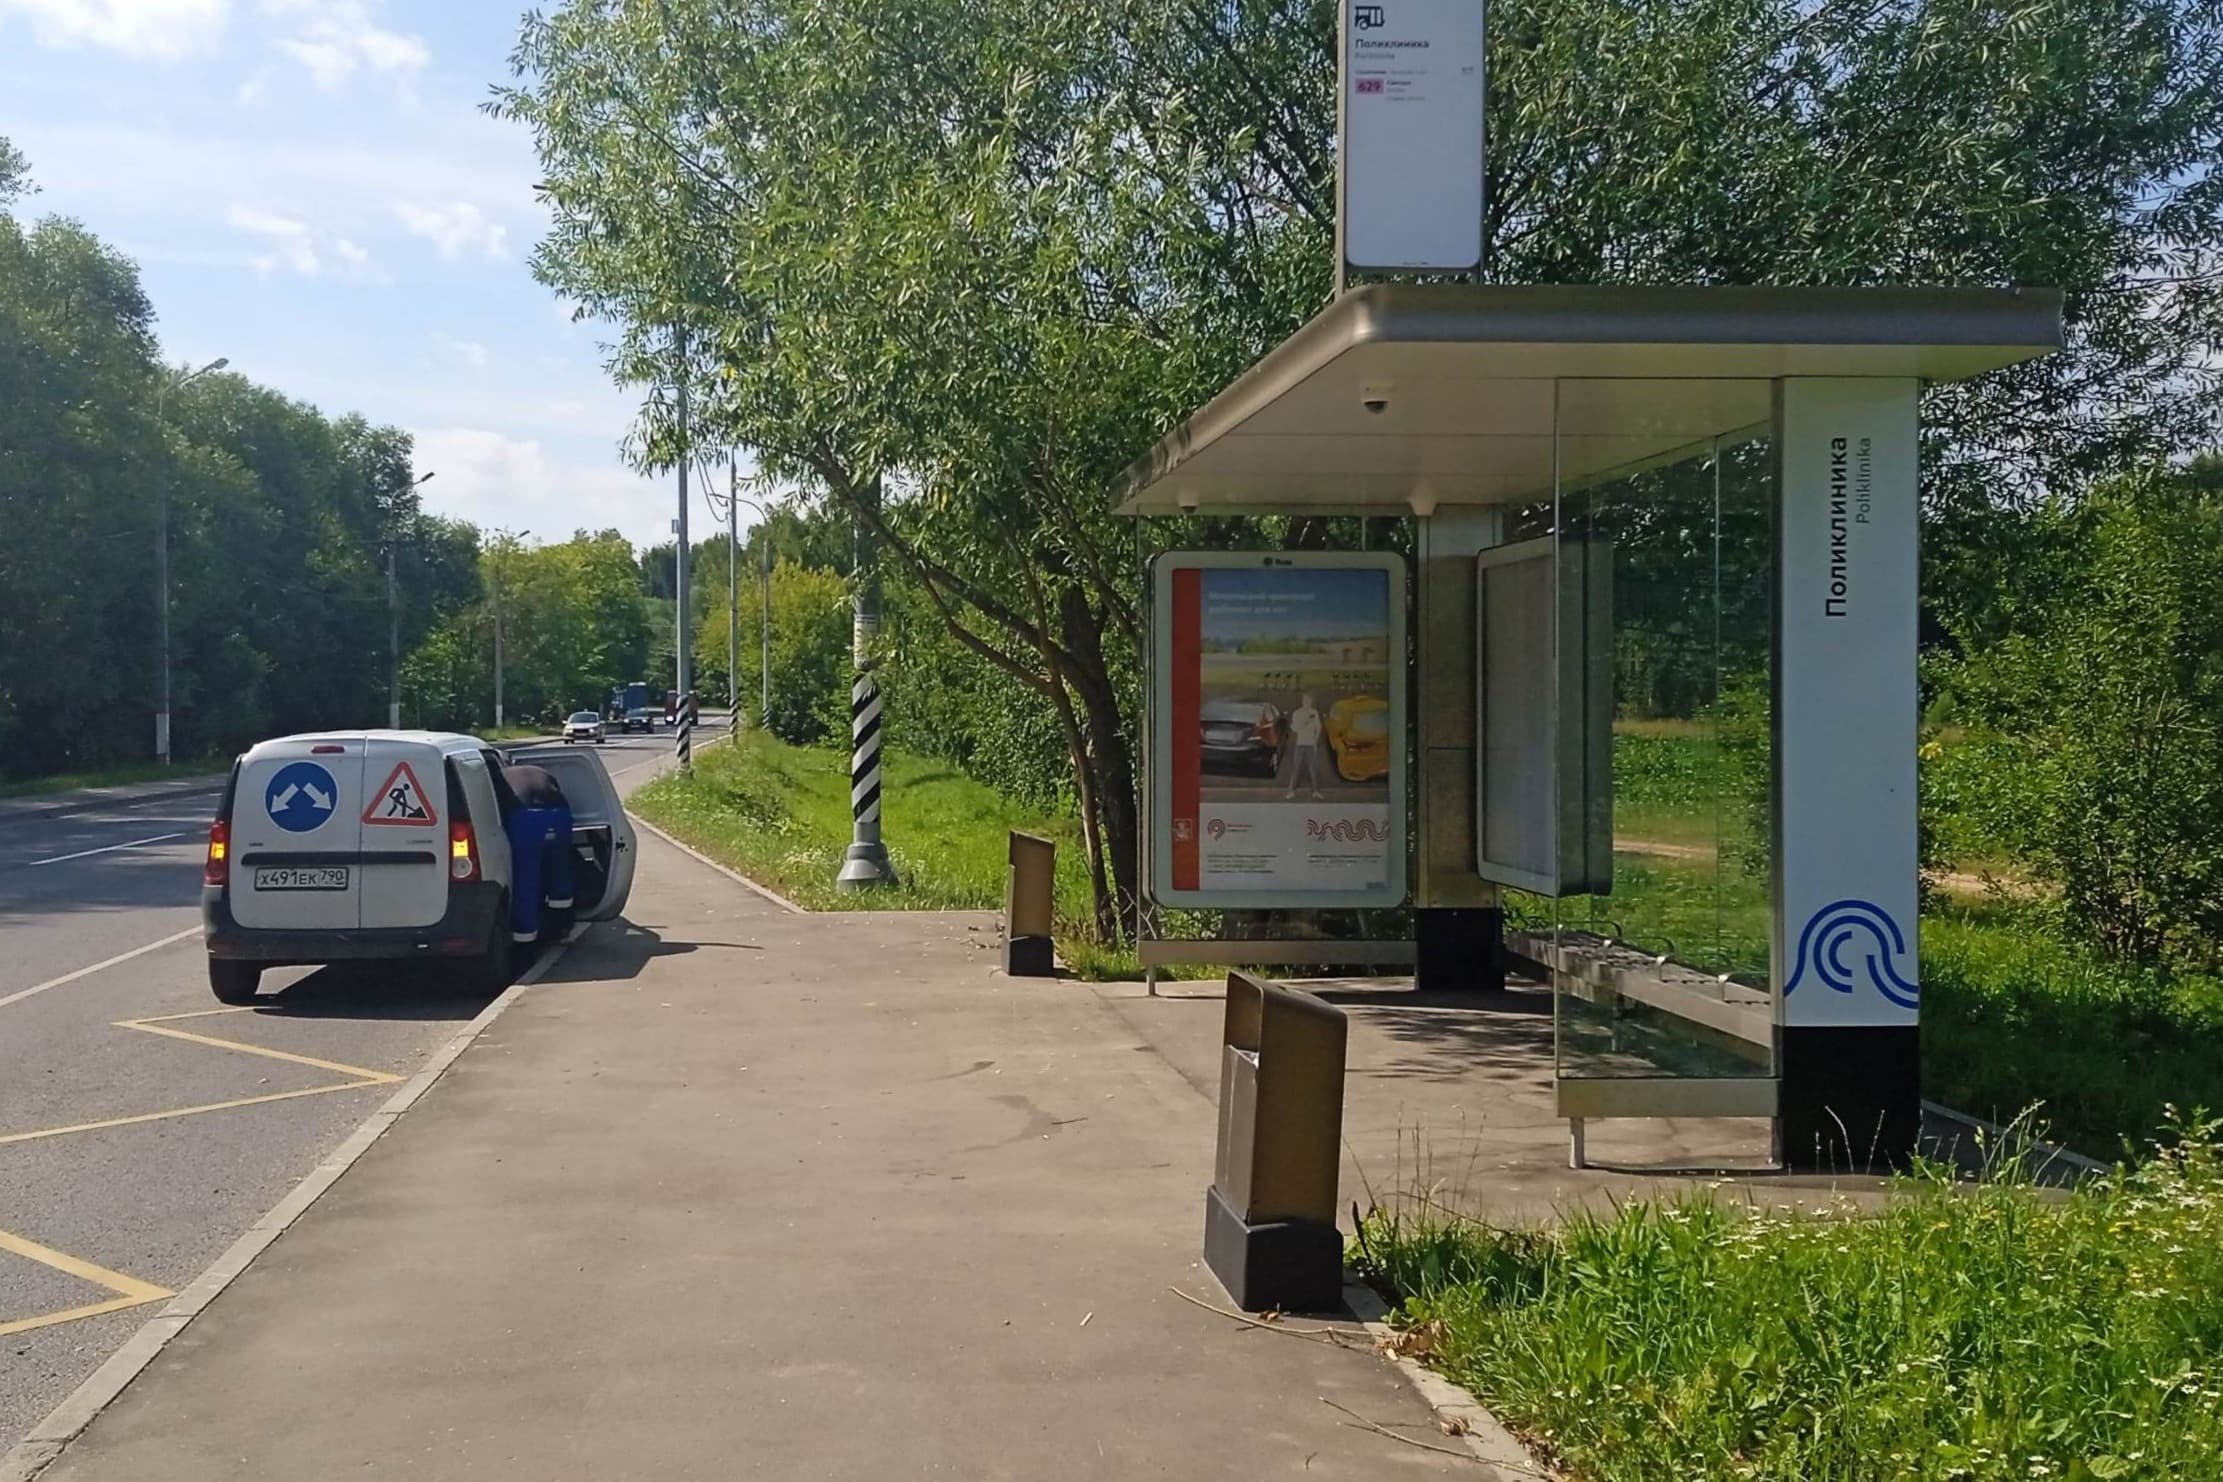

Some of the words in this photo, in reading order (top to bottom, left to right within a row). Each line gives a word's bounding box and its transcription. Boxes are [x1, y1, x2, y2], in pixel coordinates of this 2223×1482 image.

[1355, 39, 1429, 49] Поликлиника
[1357, 80, 1381, 93] 629
[1856, 437, 1871, 523] Poliklinika
[1825, 437, 1847, 616] Поликлиника
[321, 870, 344, 882] 790
